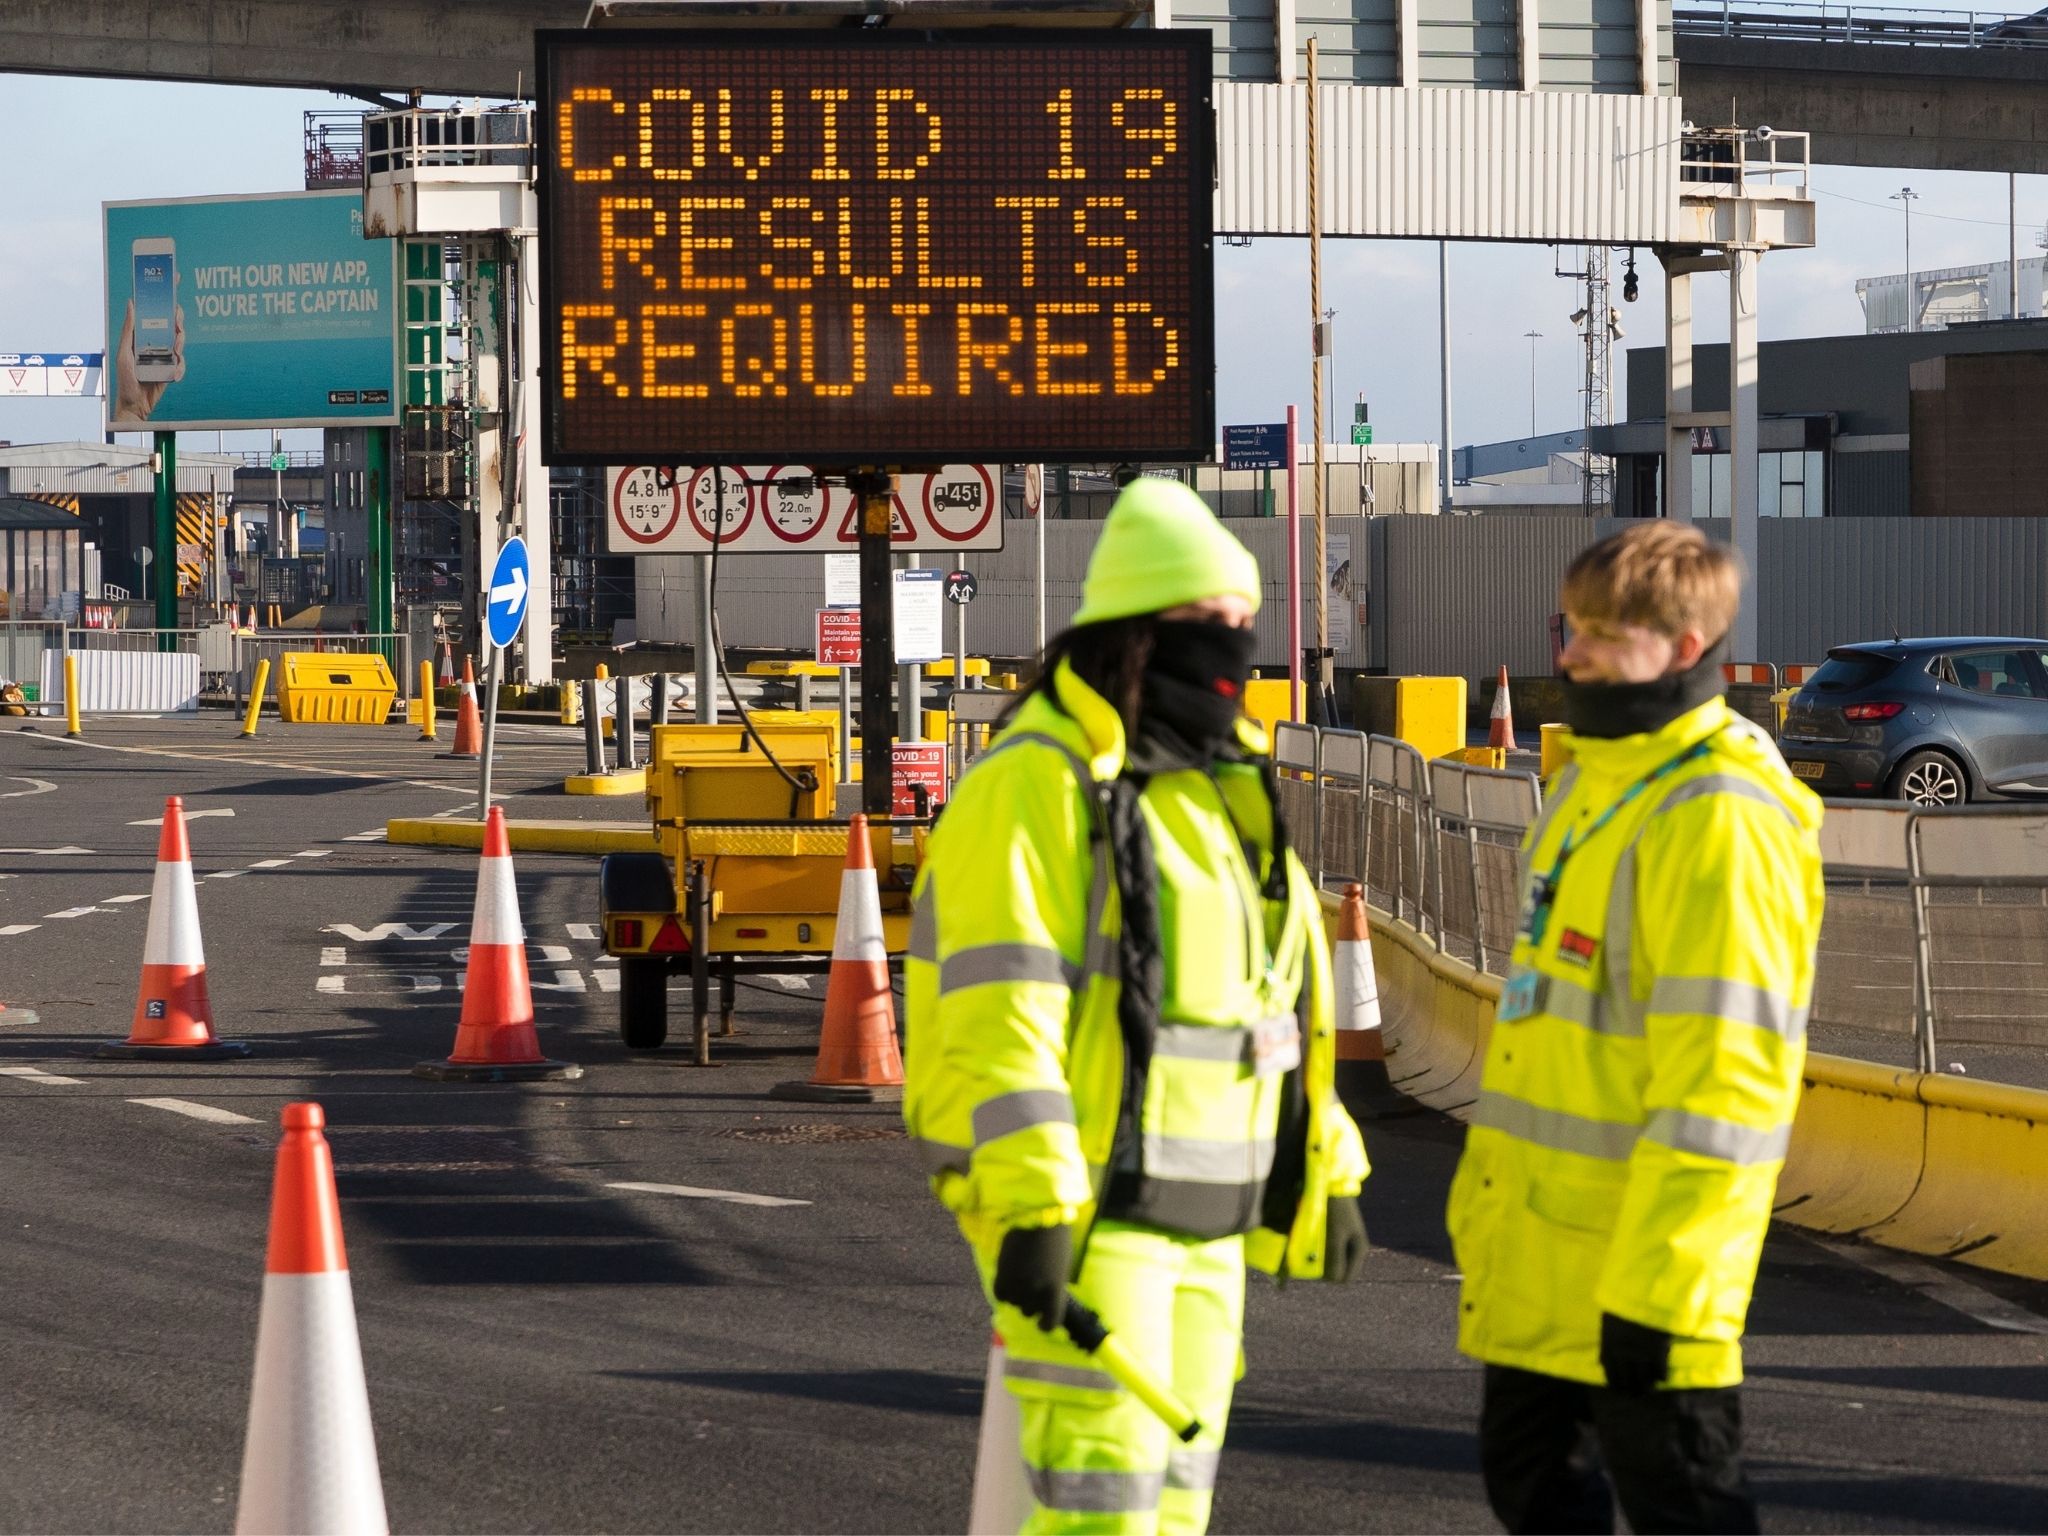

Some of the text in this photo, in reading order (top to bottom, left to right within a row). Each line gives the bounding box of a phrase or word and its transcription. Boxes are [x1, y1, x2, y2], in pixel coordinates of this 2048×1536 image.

[560, 88, 1177, 180] COVID 19
[601, 197, 1138, 290] RESULTS
[195, 260, 370, 288] WITH OUR NEW APP,
[195, 289, 378, 318] YOU'RE THE CAPTAIN
[562, 303, 1179, 398] REQUIRED
[627, 480, 654, 497] 4.8
[731, 483, 744, 494] m
[950, 485, 979, 502] 45t
[779, 502, 812, 513] 22.0m
[823, 615, 850, 623] COVID
[892, 751, 919, 761] OVID
[928, 751, 940, 761] 19
[920, 771, 938, 779] your
